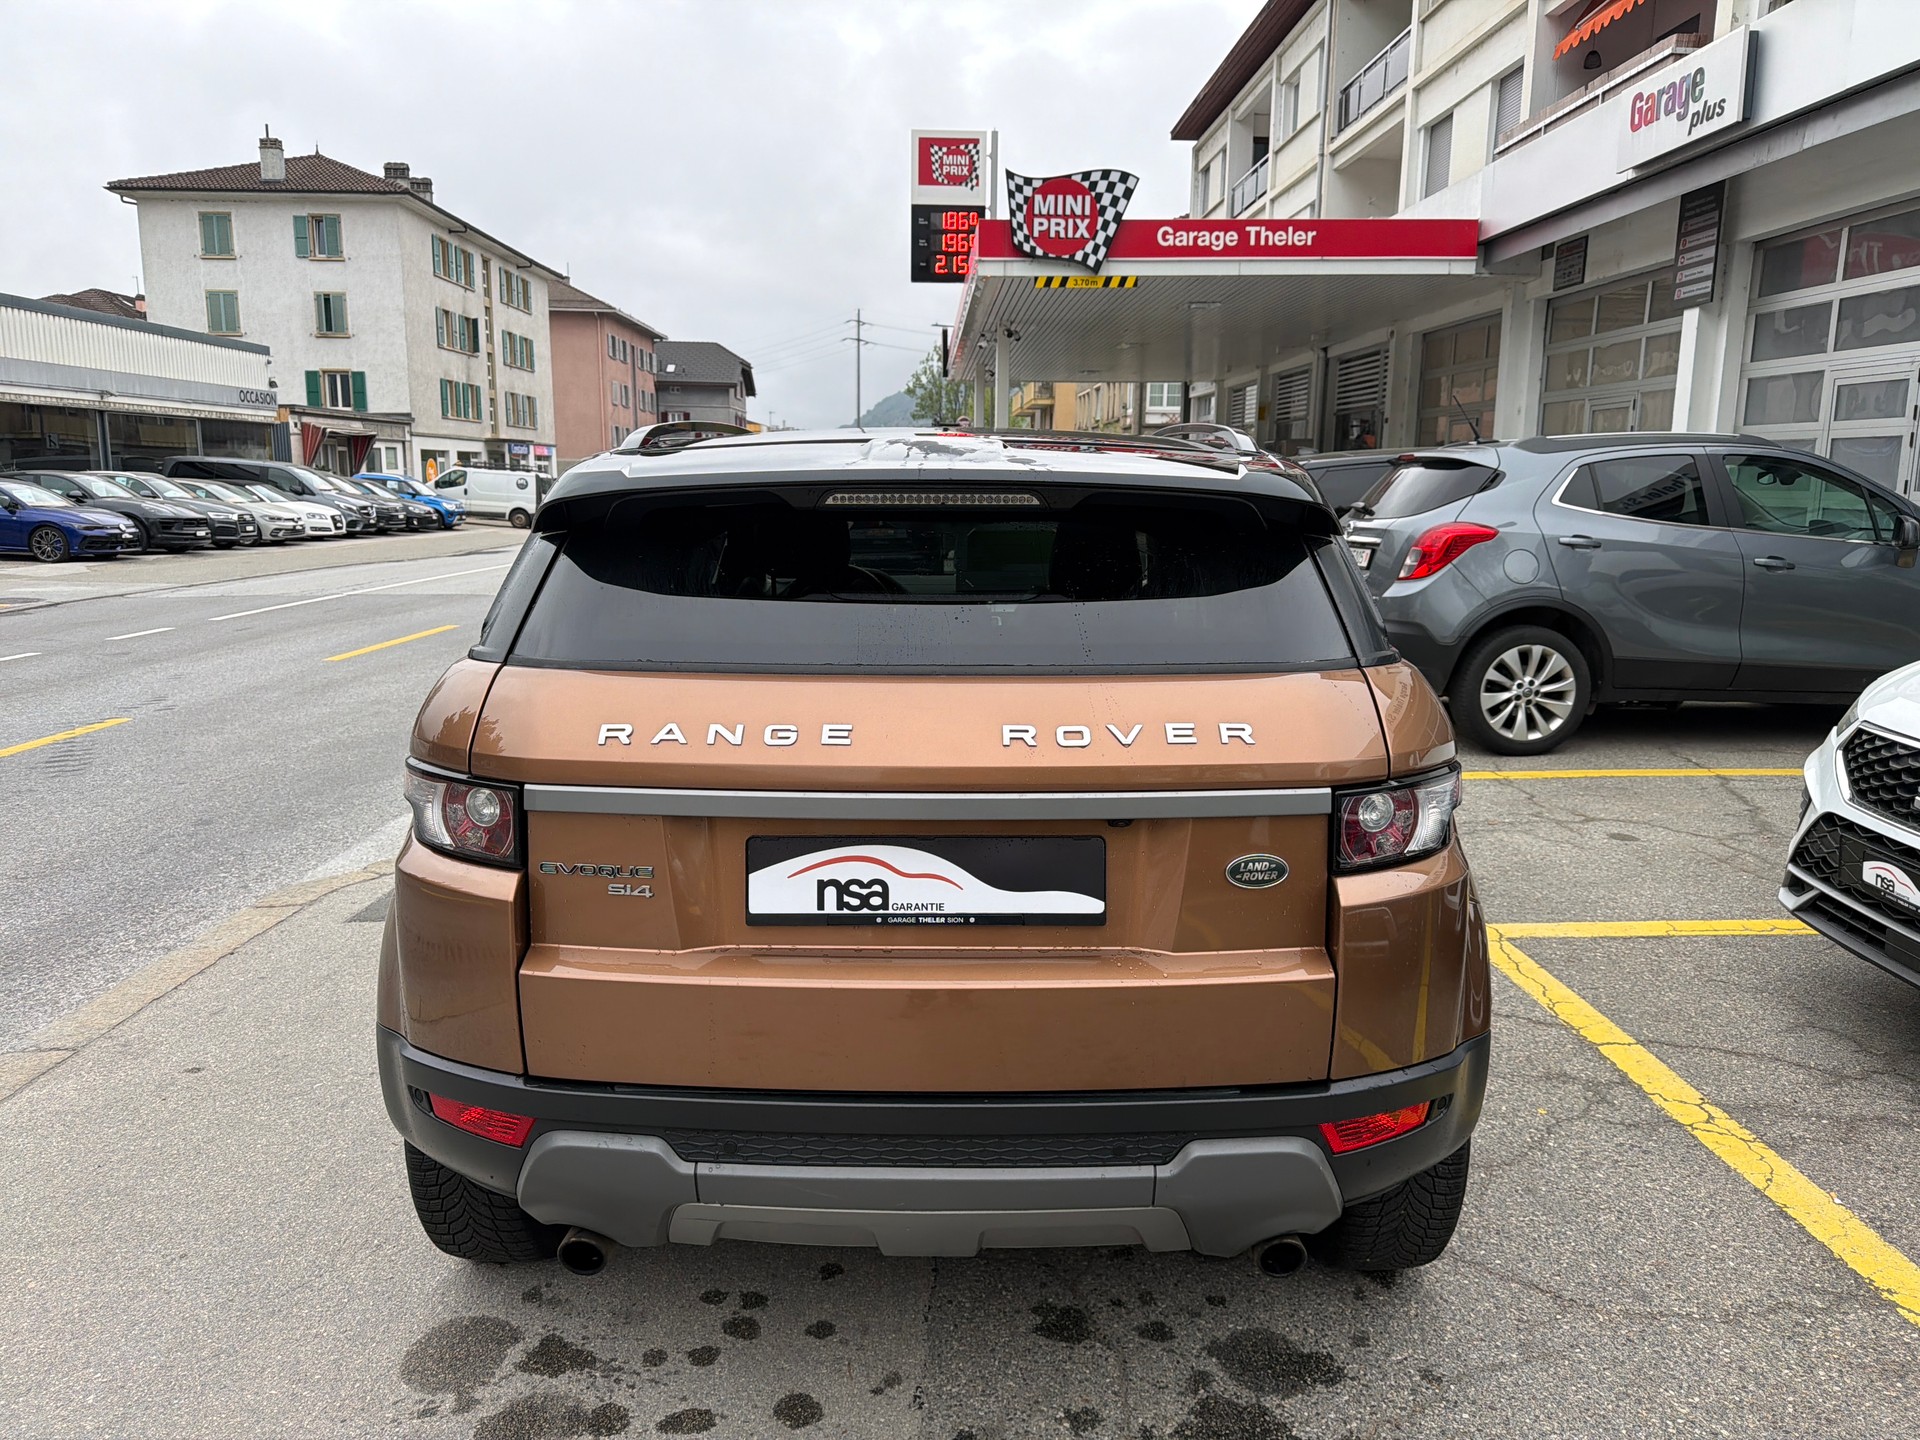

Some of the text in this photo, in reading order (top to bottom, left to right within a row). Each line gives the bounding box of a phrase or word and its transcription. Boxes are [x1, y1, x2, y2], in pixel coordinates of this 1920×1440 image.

[1630, 66, 1705, 133] Garage
[1687, 98, 1726, 136] plus
[942, 154, 970, 166] MINI
[942, 166, 970, 176] PRIX
[1033, 194, 1091, 216] MINI
[1032, 217, 1091, 239] PRIX
[1156, 225, 1317, 251] Garage Theler
[239, 389, 277, 405] OCCASION
[597, 722, 1257, 747] RANGE ROVER
[539, 861, 654, 879] EVOQUE
[1240, 862, 1270, 872] LAND
[1241, 871, 1279, 881] ROVER
[1876, 873, 1894, 893] nsa
[816, 878, 890, 912] nsa
[891, 902, 945, 912] GARANTIE
[887, 916, 964, 924] GARAGE THELER SION
